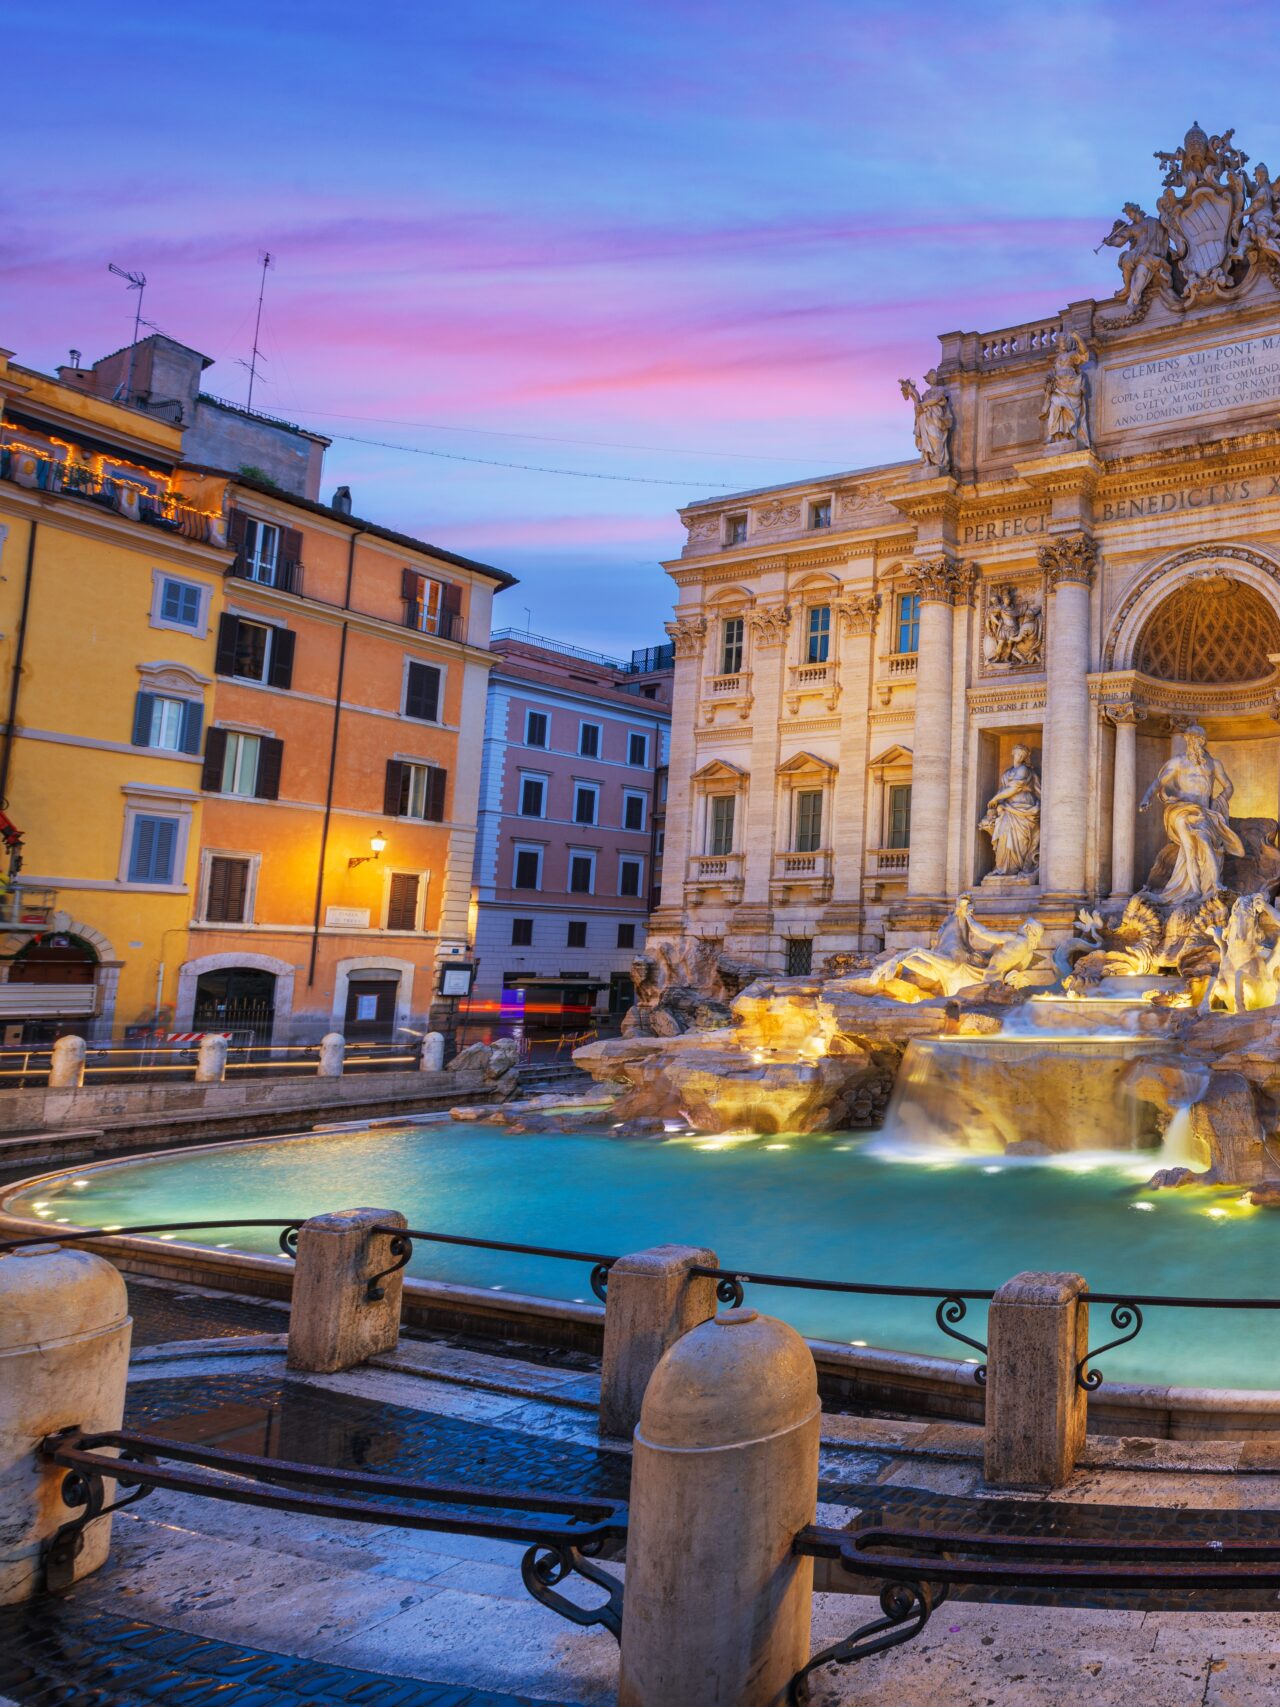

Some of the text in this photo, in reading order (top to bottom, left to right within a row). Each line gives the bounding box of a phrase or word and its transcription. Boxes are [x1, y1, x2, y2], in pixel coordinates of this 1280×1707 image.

[1122, 358, 1180, 380] CLEMENS
[1203, 356, 1255, 374] VIRGINEM
[1111, 393, 1139, 405] COPIA
[1143, 388, 1154, 399] ET
[1157, 375, 1221, 396] SALVBRITATE
[1135, 398, 1166, 411] CVLTV
[1172, 385, 1230, 404] MAGNIFICO
[1114, 414, 1144, 427] ANNO
[1146, 405, 1183, 421] DOMINI
[1102, 479, 1250, 522] BENEDICTVS
[1020, 701, 1028, 710] ET
